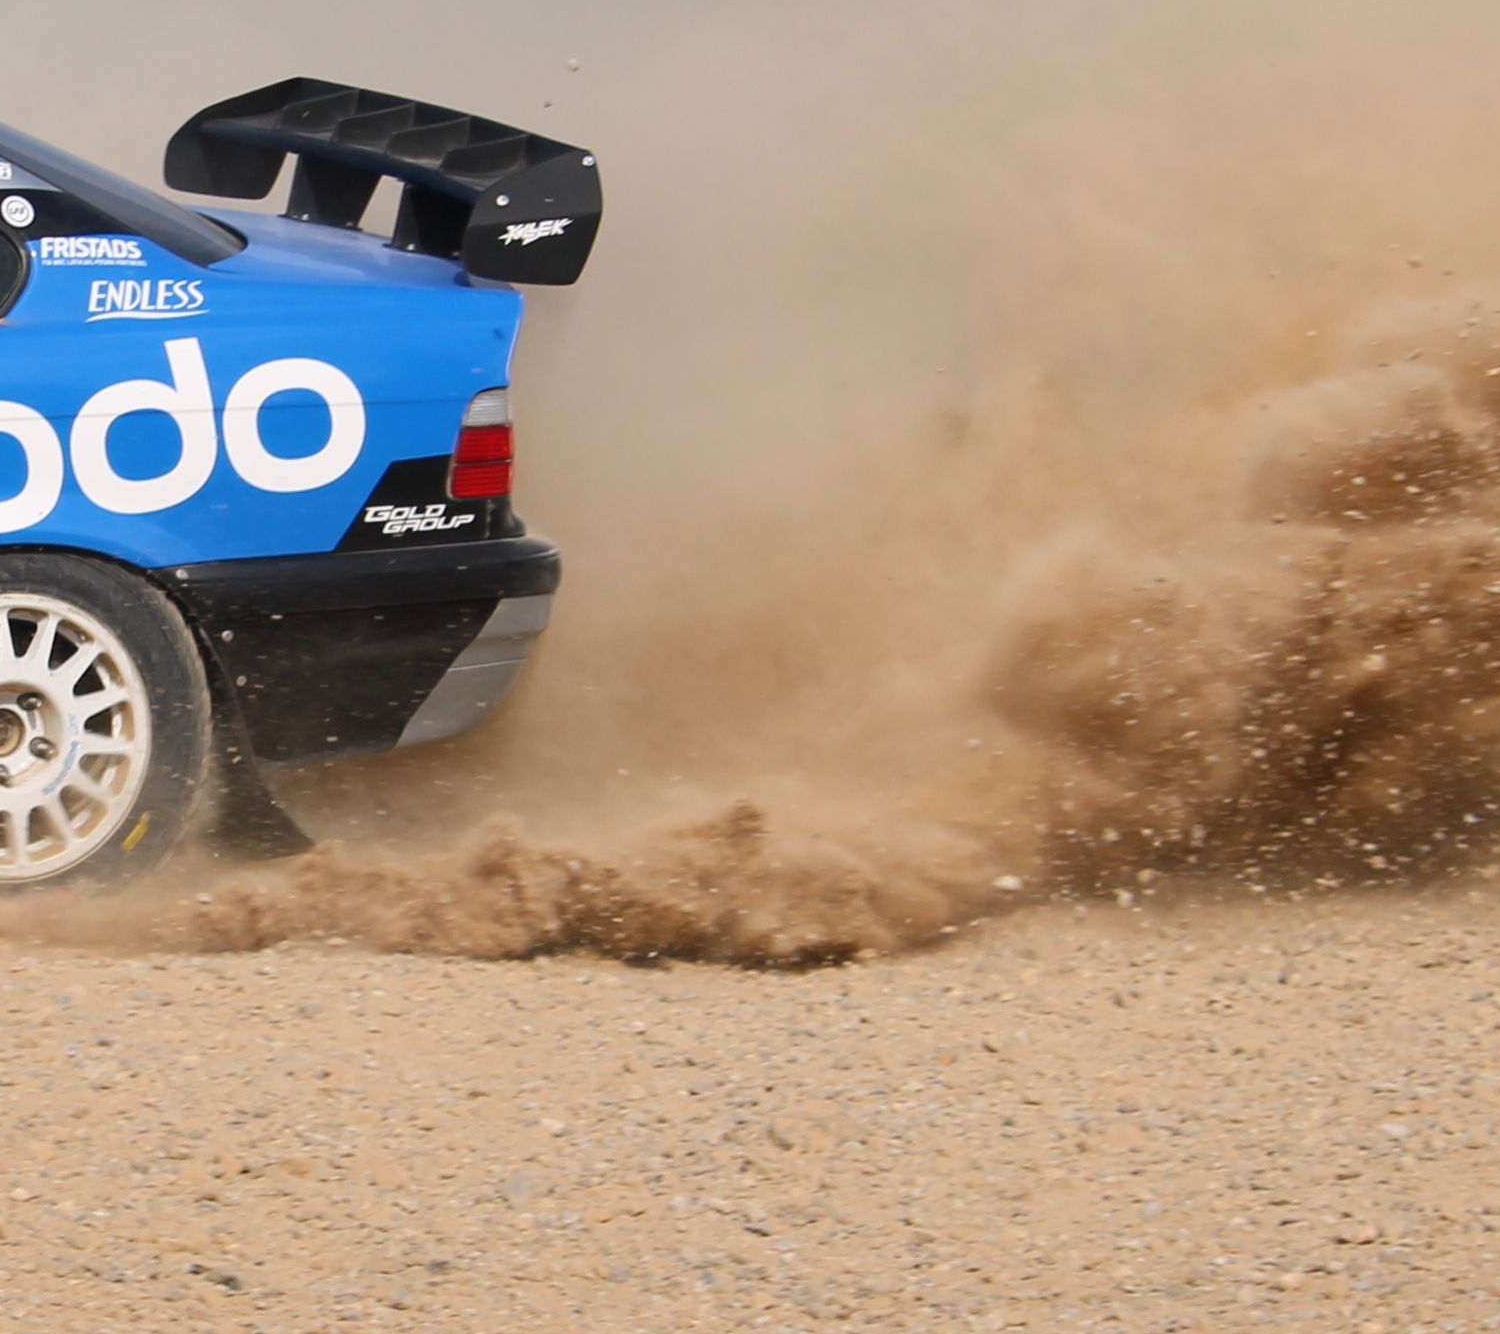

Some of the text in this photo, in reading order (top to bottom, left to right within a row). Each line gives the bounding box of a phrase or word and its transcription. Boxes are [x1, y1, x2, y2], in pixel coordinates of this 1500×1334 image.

[40, 237, 142, 259] FRISTADS
[88, 279, 205, 312] ENDLESS
[363, 503, 447, 523] GOLD
[382, 514, 475, 535] GROUP
